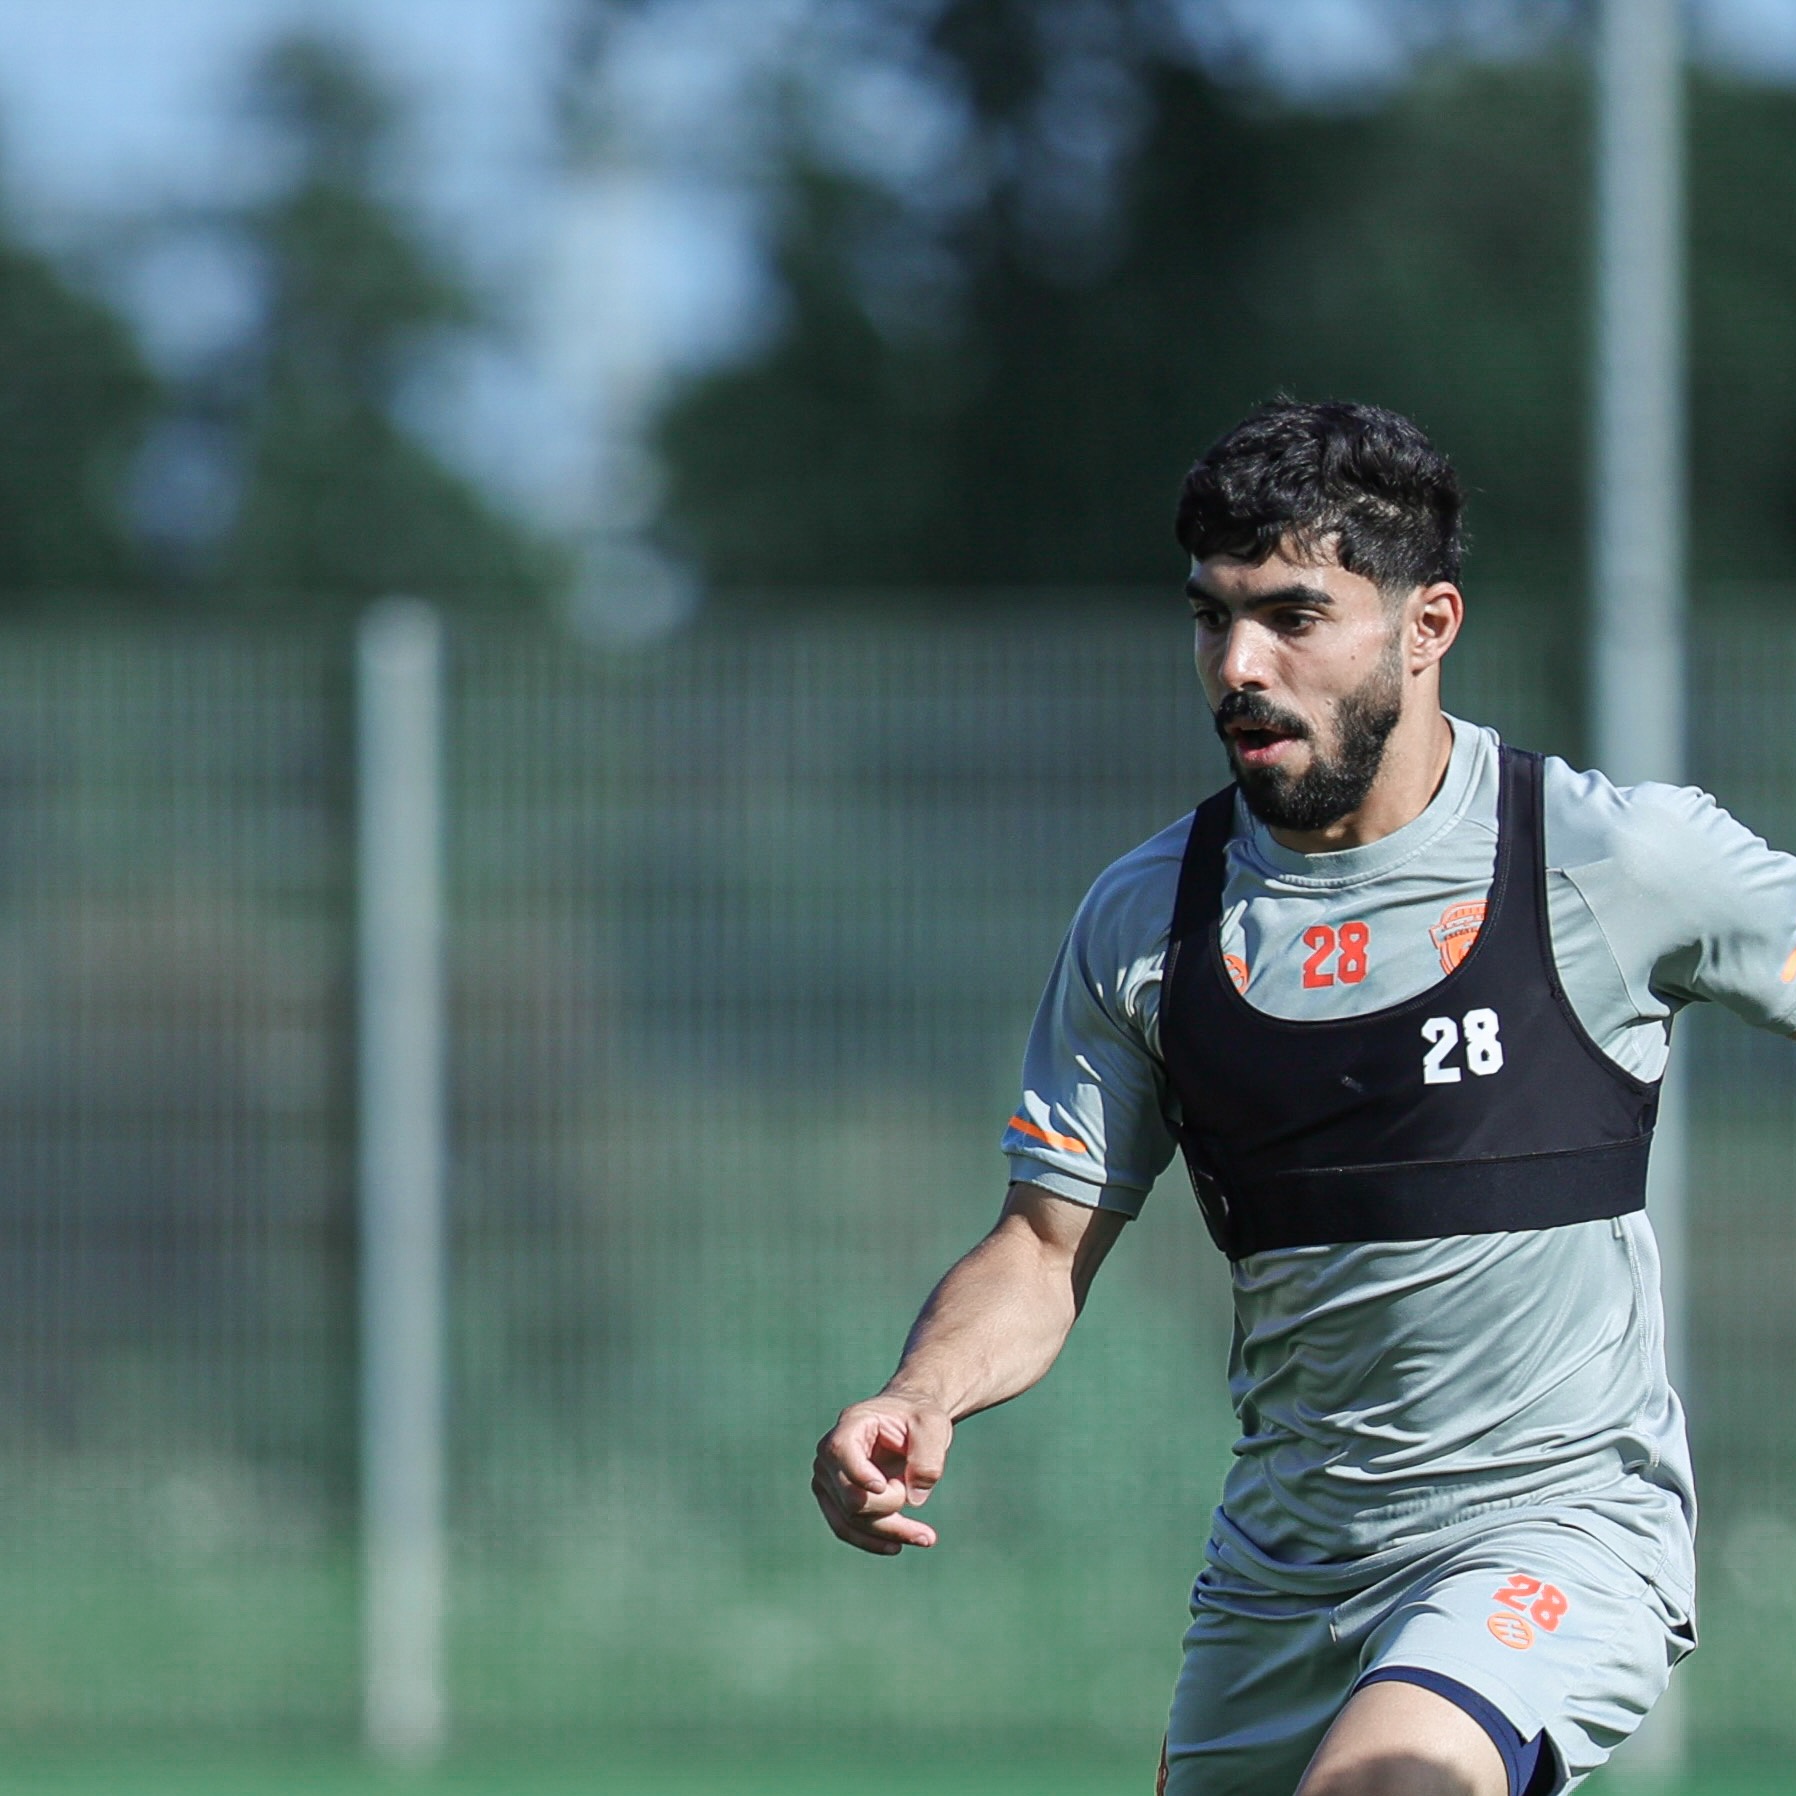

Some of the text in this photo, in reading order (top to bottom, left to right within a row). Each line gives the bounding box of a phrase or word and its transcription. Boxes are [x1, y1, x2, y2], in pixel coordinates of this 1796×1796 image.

[1302, 922, 1370, 988] 28
[1421, 1007, 1503, 1084] 28
[1492, 1574, 1569, 1632] 28
